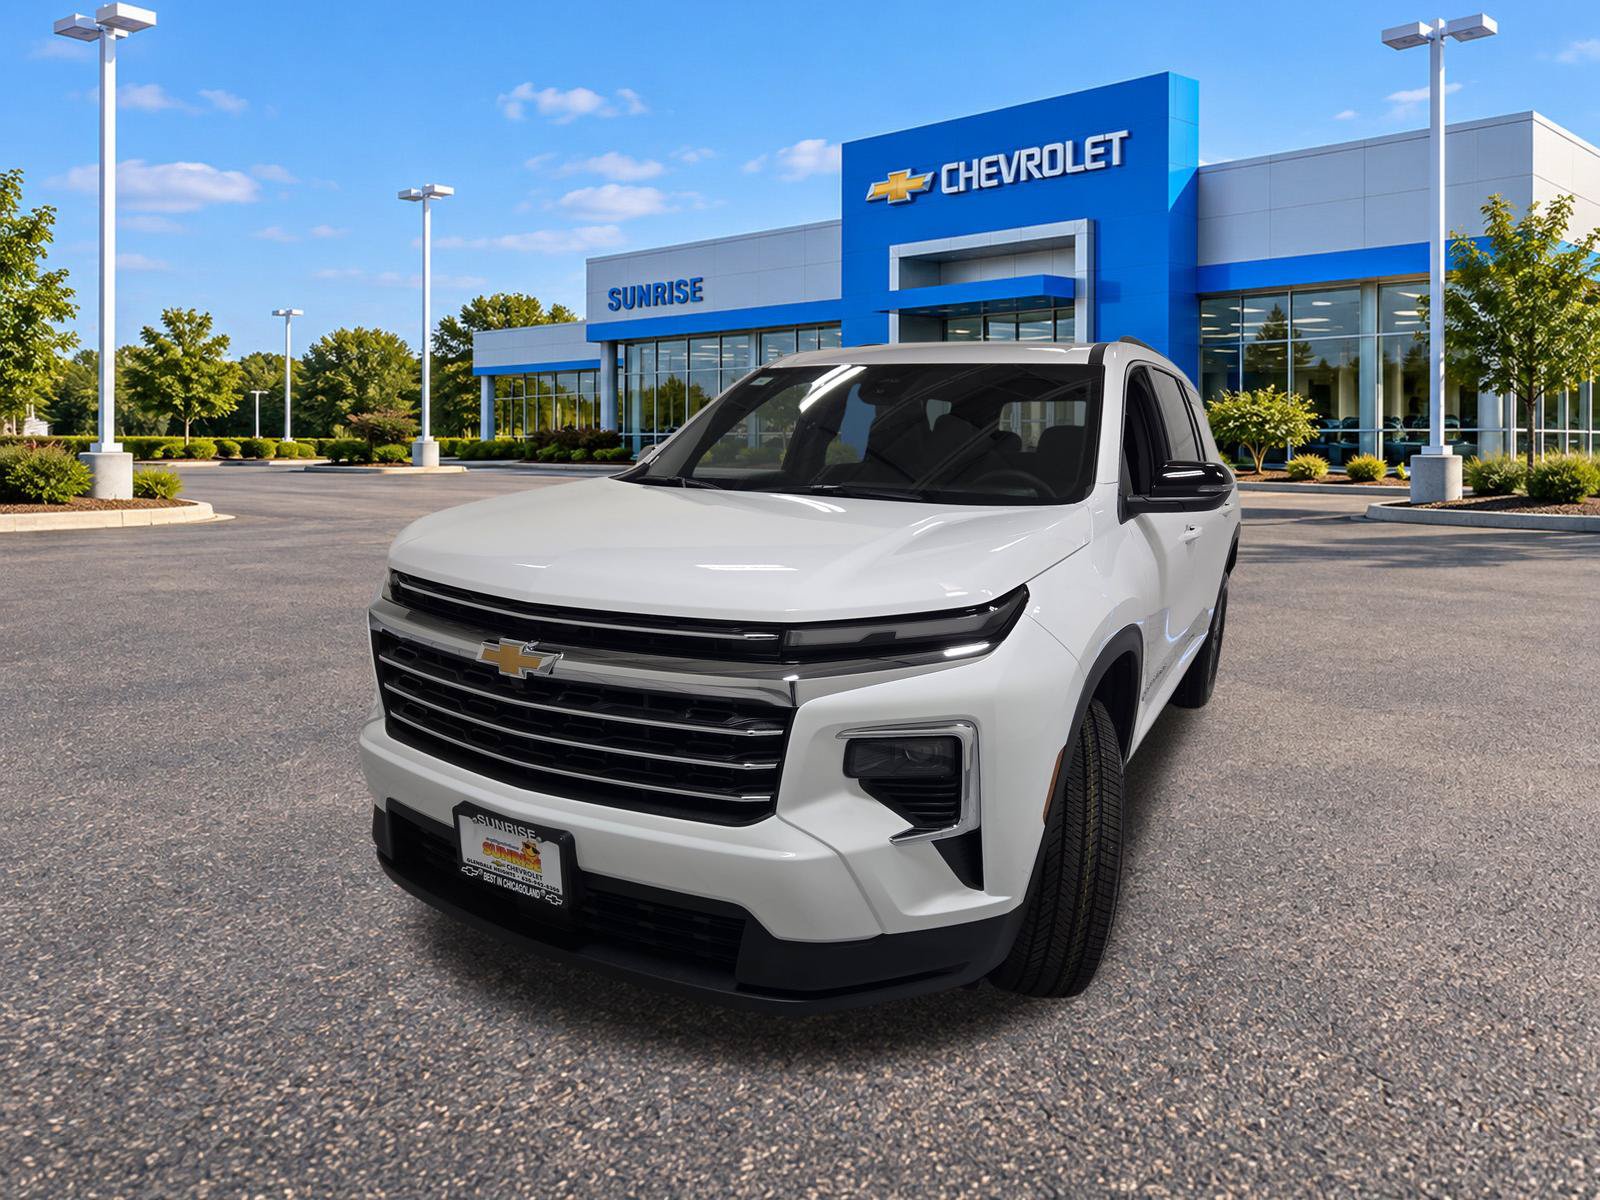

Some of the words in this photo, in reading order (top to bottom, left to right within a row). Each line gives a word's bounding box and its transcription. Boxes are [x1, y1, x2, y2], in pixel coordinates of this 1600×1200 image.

[940, 130, 1129, 195] CHEVROLET
[608, 277, 704, 312] SUNRISE
[477, 814, 536, 838] SUNRISE
[466, 858, 493, 870] GLENDALE
[494, 865, 516, 878] HEIGHTS
[482, 841, 543, 874] SUNRISE
[483, 872, 496, 884] BEST
[496, 876, 503, 887] IN
[502, 877, 541, 899] CHICAGOLAND
[506, 864, 543, 880] CHEVROLET
